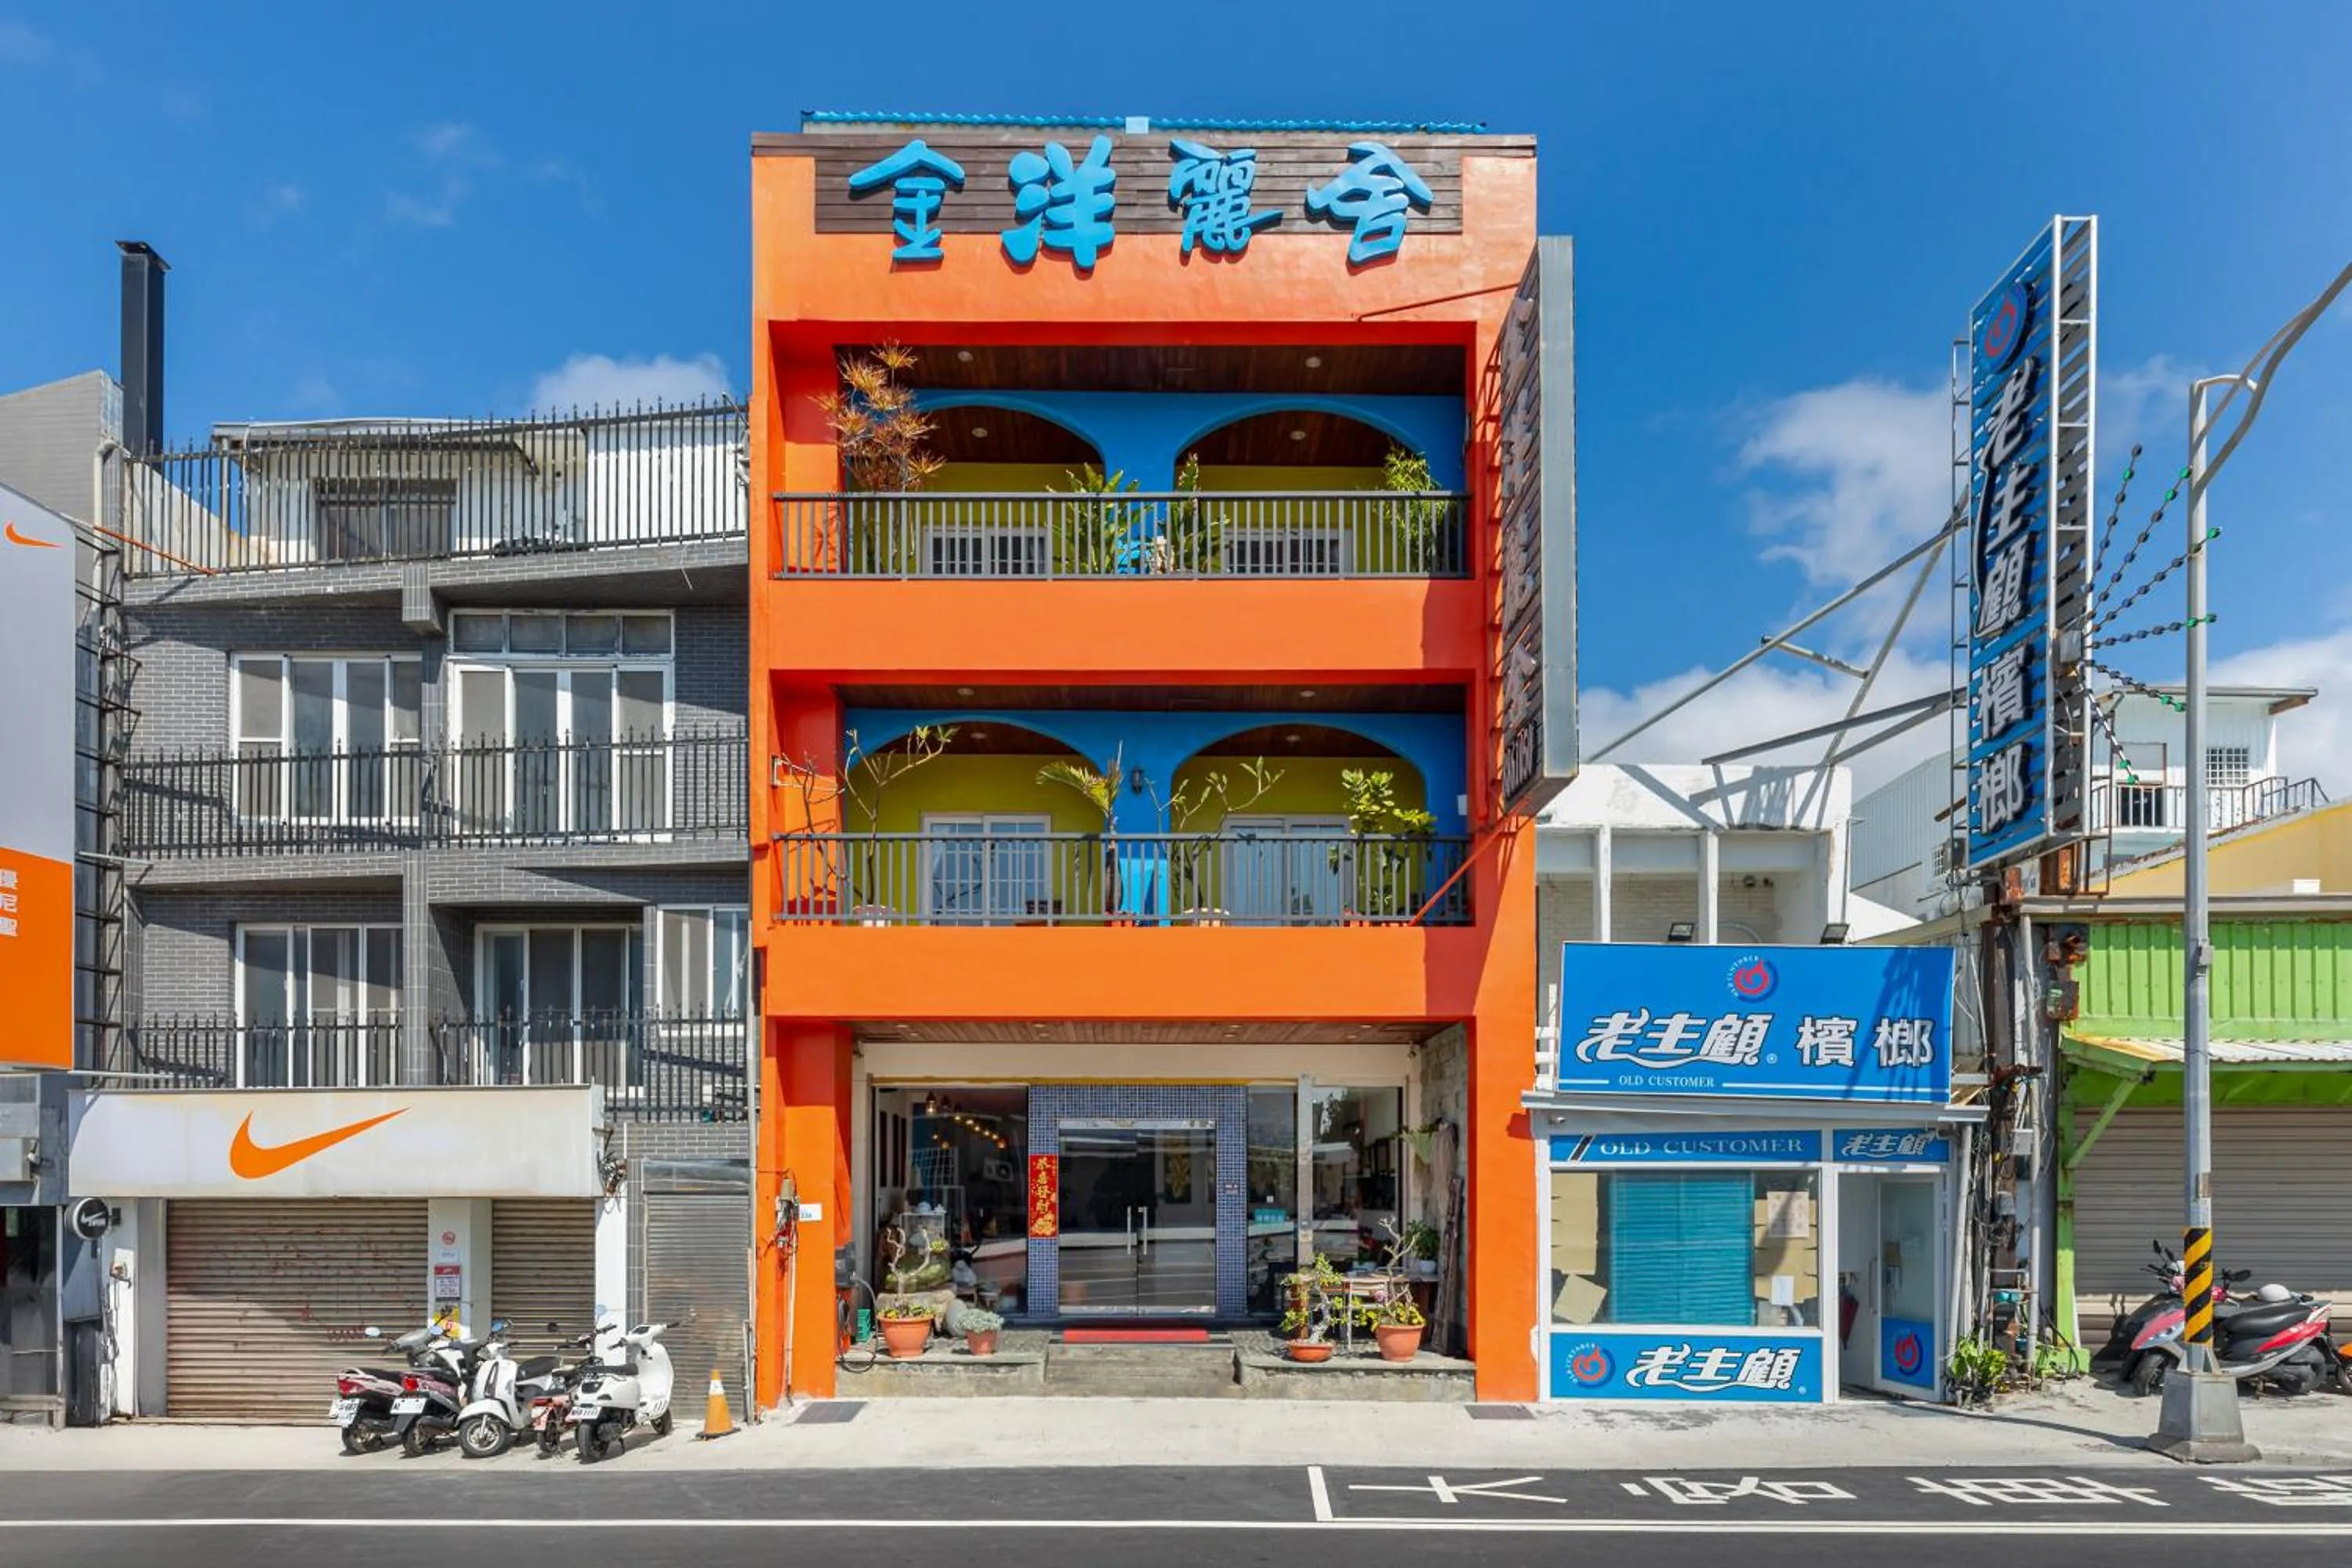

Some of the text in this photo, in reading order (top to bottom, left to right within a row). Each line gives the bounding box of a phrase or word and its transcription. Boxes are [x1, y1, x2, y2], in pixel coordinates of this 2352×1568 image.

[1977, 646, 2027, 834] 檳榔
[1797, 1016, 1936, 1068] 檳榔
[1618, 1075, 1715, 1088] OLD CUSTOMER
[1600, 1138, 1802, 1155] OLD CUSTOMER
[1625, 1342, 1803, 1392] 老主顧
